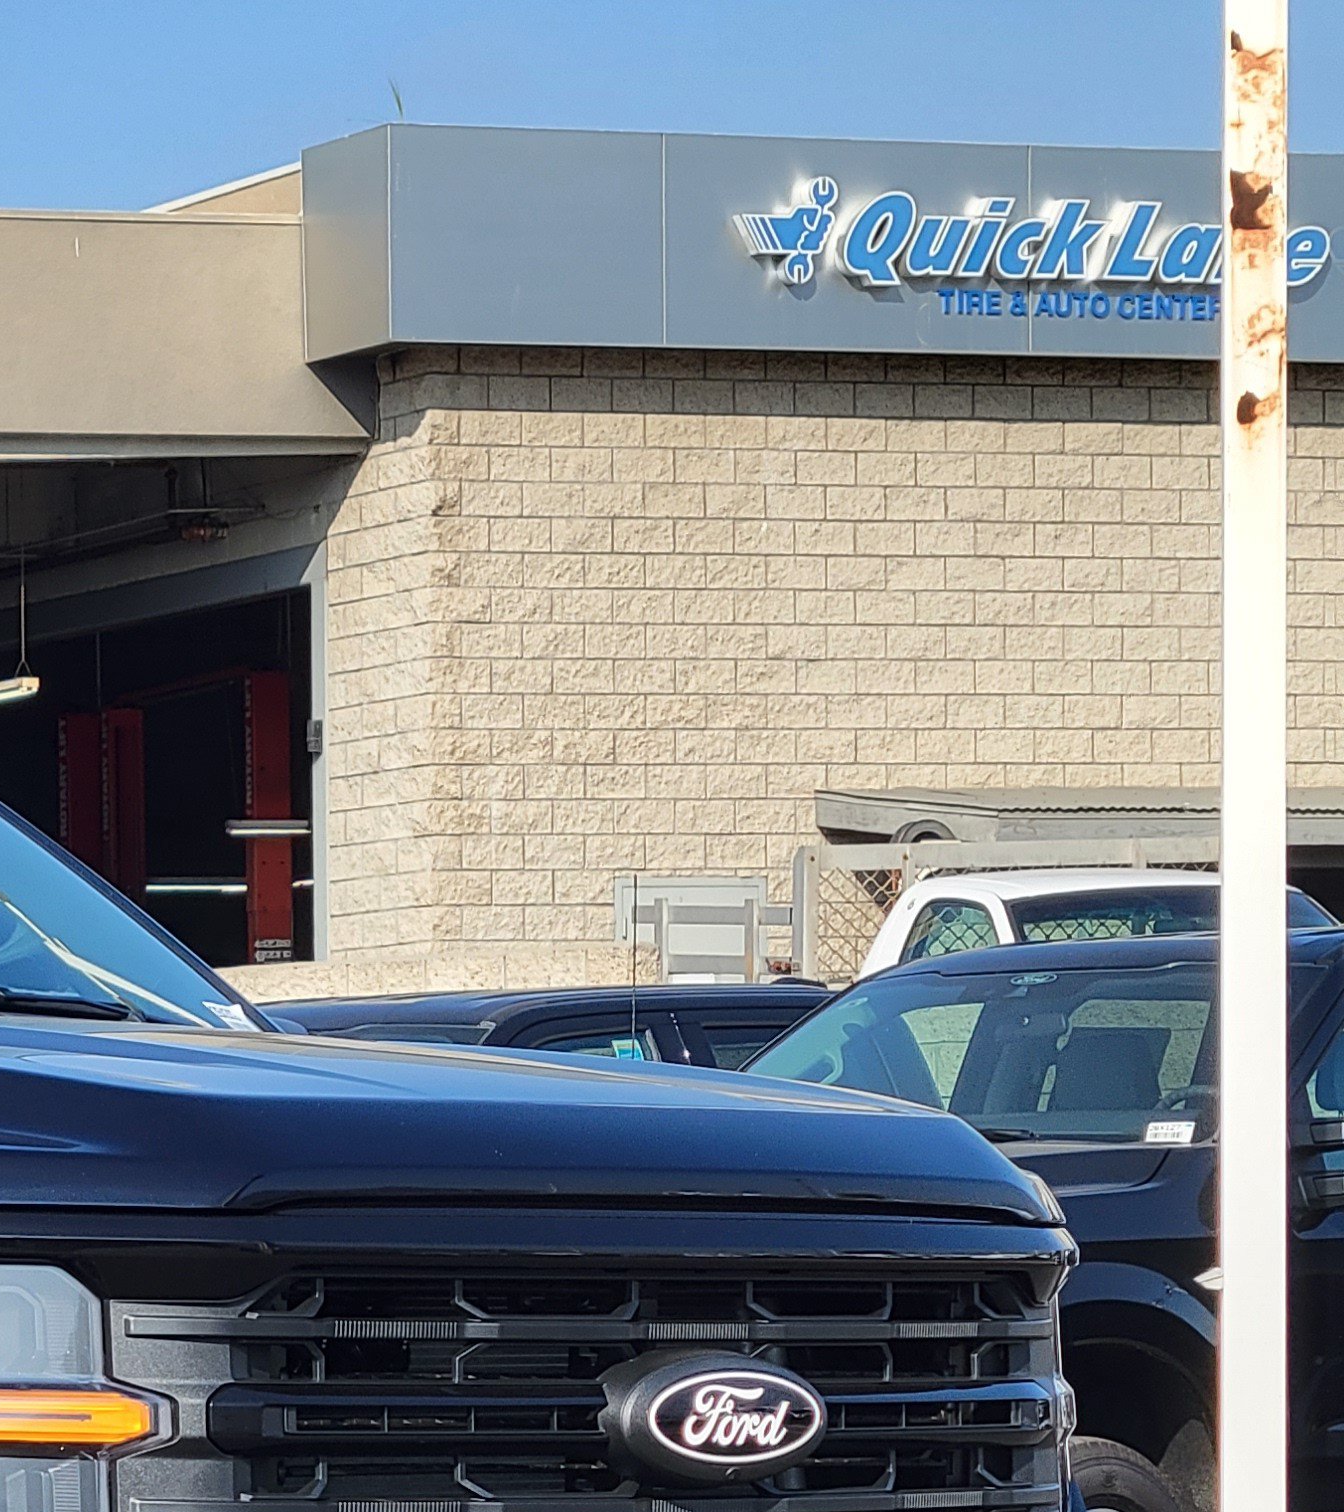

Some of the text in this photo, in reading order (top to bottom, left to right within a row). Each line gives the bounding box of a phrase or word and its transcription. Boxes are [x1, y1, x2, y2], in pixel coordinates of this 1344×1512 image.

[845, 191, 1330, 287] Quick Lae
[937, 289, 1002, 316] TIRE
[1011, 291, 1028, 317] &
[1034, 291, 1112, 319] AUTO
[684, 1384, 791, 1447] Ford
